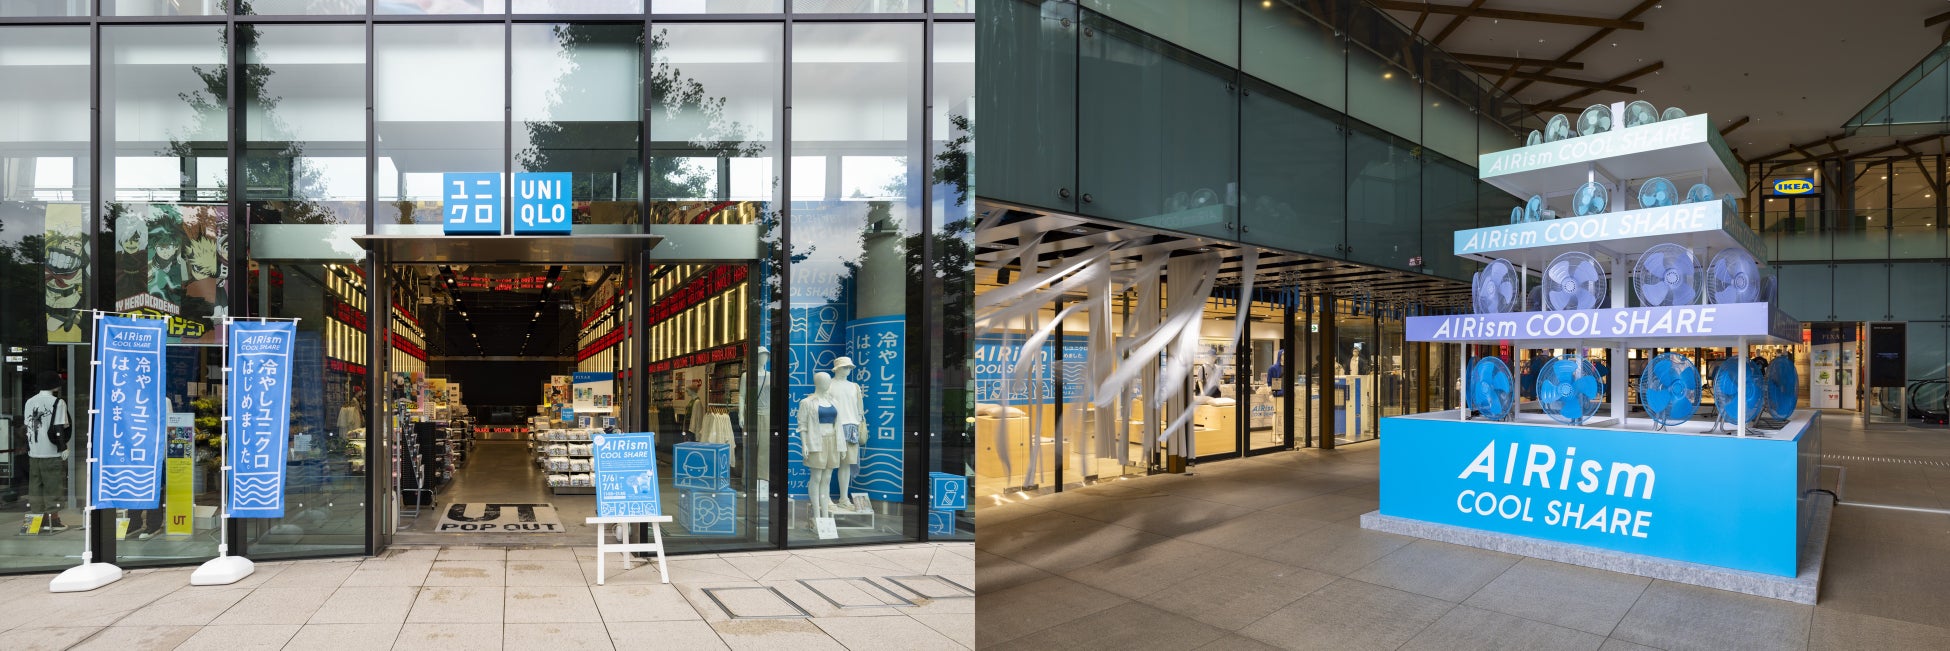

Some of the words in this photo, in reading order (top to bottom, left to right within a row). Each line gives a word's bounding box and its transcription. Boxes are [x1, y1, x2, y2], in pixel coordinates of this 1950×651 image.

[1488, 151, 1553, 174] AIRism
[1560, 136, 1614, 161] COOL
[1621, 121, 1695, 148] SHARE
[521, 180, 561, 200] UNI
[1778, 183, 1811, 191] IKEA
[521, 203, 565, 227] QLO
[1462, 229, 1538, 251] AIRism
[1544, 218, 1608, 243] COOL
[1617, 205, 1706, 235] SHARE
[790, 267, 840, 285] IRis
[124, 293, 145, 310] HERO
[145, 293, 180, 315] ACADEMIA
[1432, 316, 1517, 339] AIRism
[1525, 312, 1602, 337] COOL
[1611, 307, 1717, 335] SHARE
[113, 331, 152, 341] AIRism
[242, 335, 282, 344] AIRism
[975, 345, 1048, 362] AIRim
[975, 364, 1002, 374] OOL
[1006, 364, 1047, 374] SAE
[876, 331, 899, 441] 冷やしユニクロ
[110, 355, 130, 463] はじめました。
[130, 356, 152, 462] 冷やしユニクロ
[241, 359, 254, 470] はじめました。
[254, 358, 279, 469] 冷やしユニクロ
[600, 439, 648, 451] AIRism
[600, 451, 621, 459] COOL
[623, 450, 649, 458] SHARE
[1457, 439, 1656, 500] AIRism
[173, 515, 186, 526] UT
[447, 503, 549, 522] UT
[1456, 489, 1534, 523] COOL
[1544, 499, 1653, 539] SHARE
[440, 523, 497, 531] POP
[503, 523, 557, 531] OUT
